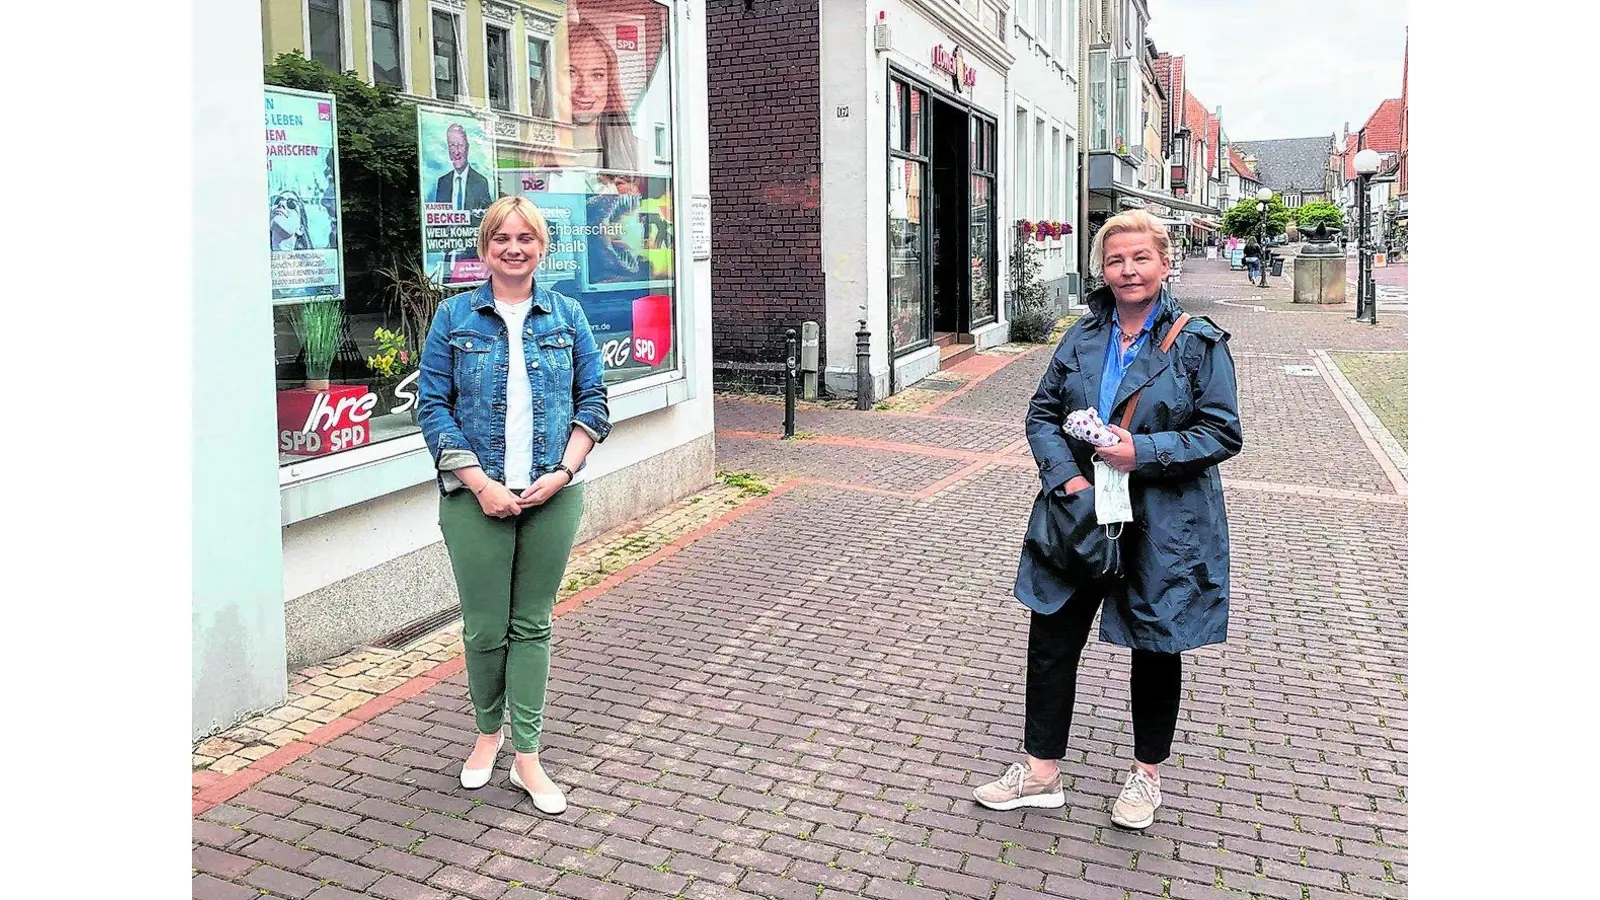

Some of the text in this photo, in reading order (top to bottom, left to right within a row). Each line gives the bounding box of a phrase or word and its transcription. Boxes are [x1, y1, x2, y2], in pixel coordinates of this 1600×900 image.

[616, 40, 636, 50] SPD
[271, 114, 303, 125] LEBEN
[427, 213, 469, 223] BECKER.
[427, 227, 480, 238] WEIL KOMPE
[548, 223, 626, 235] chbarschaft.
[427, 239, 464, 249] WICHTIG
[549, 240, 586, 252] shalb
[635, 338, 655, 360] SPD
[302, 392, 377, 435] Ihre
[280, 430, 320, 452] SPD
[330, 424, 364, 451] SPD
